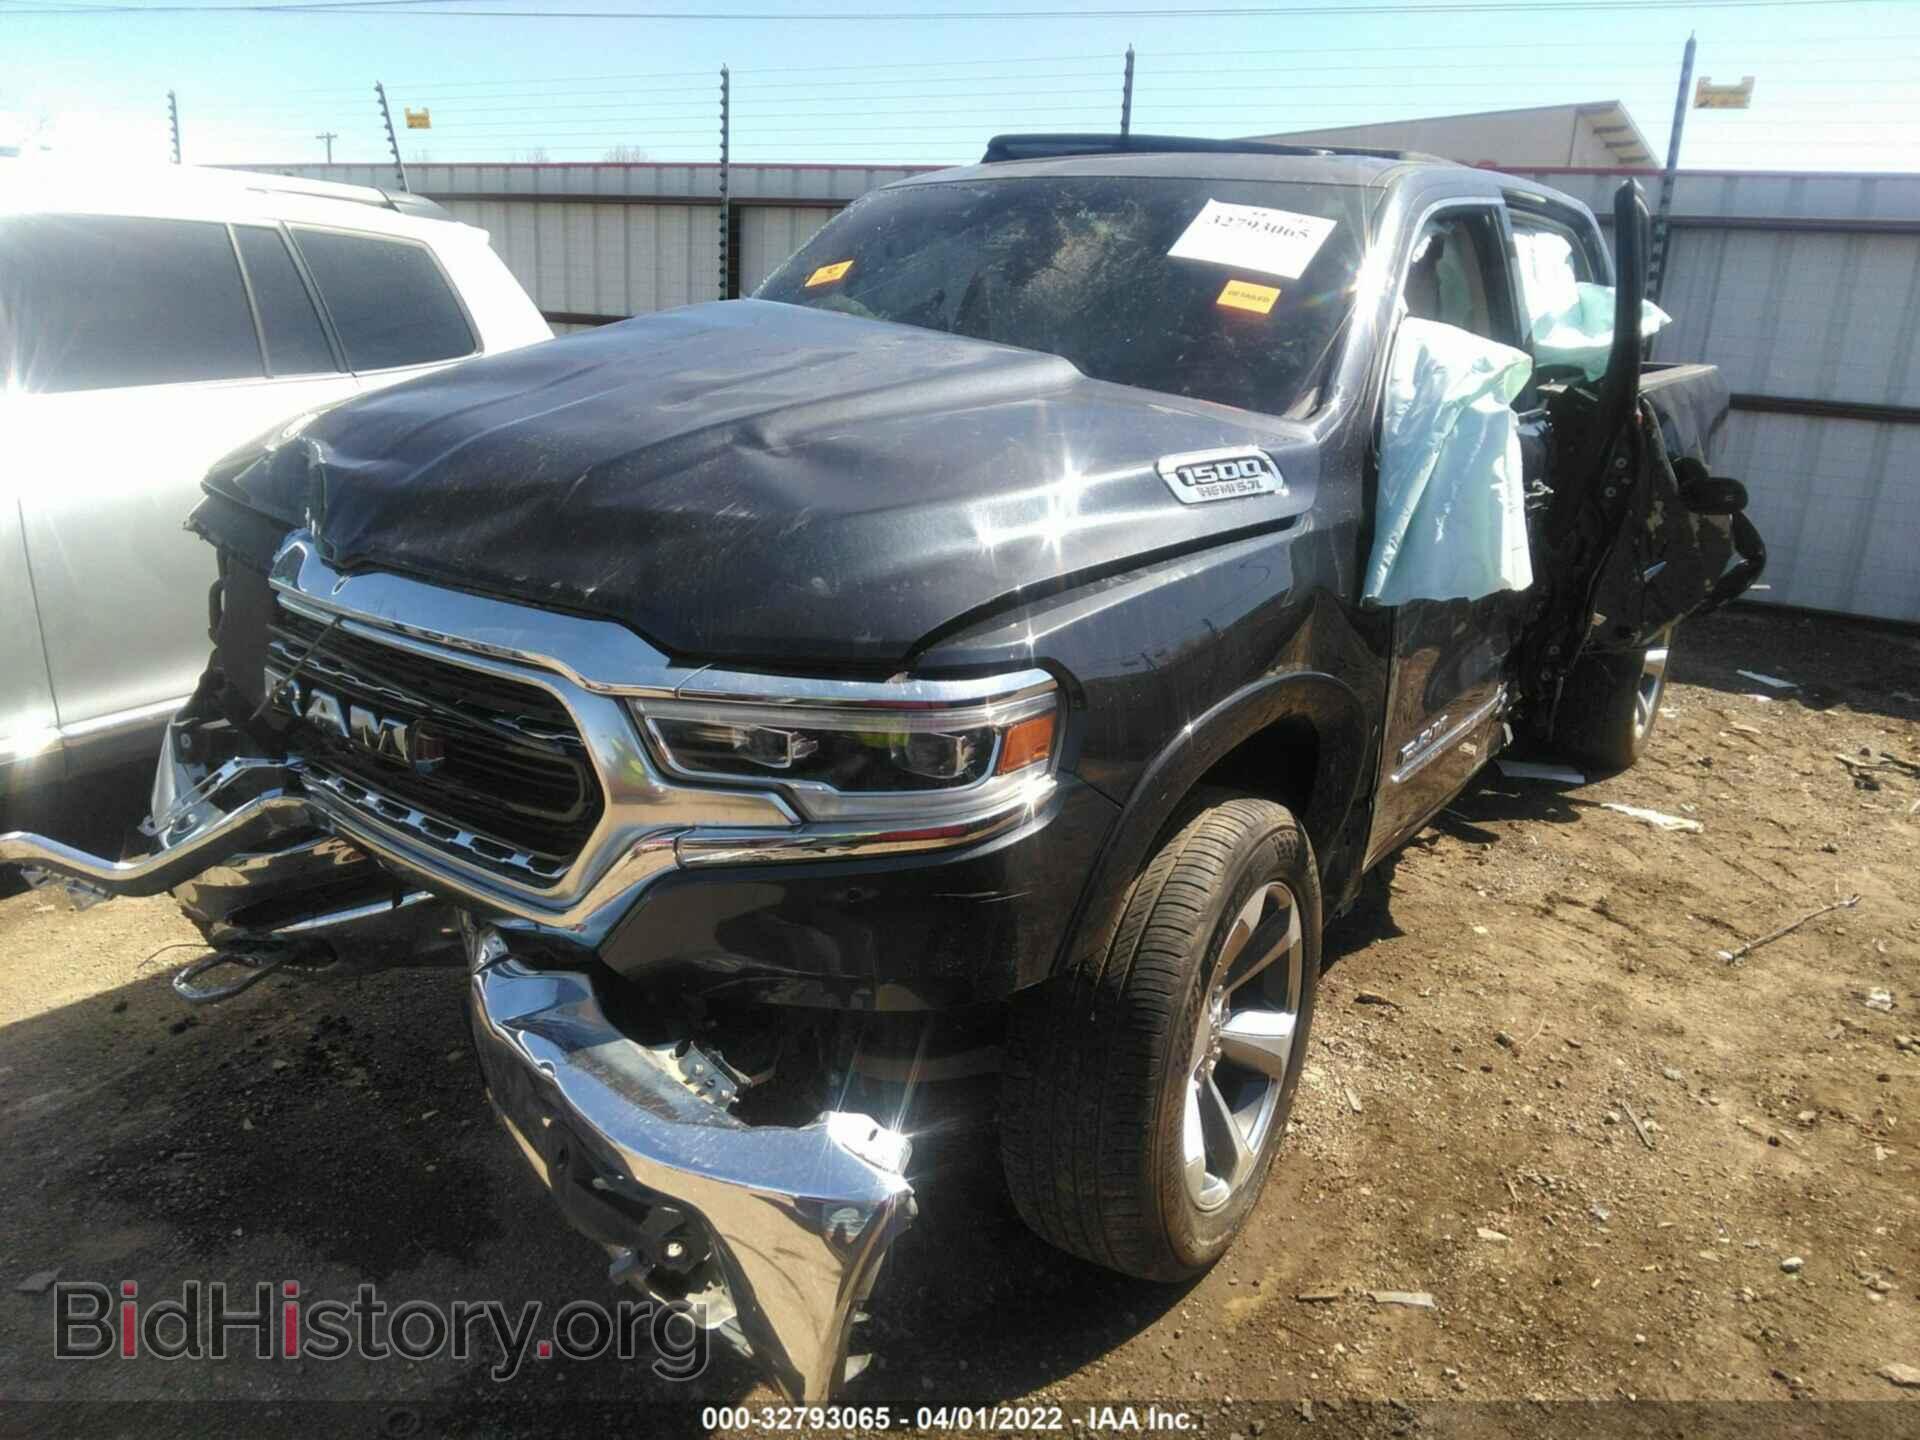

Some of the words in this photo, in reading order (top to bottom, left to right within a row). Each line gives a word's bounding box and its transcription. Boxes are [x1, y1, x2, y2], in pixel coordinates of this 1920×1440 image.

[1177, 459, 1261, 487] 1500
[1196, 484, 1236, 497] HEMI
[264, 666, 410, 763] RAM
